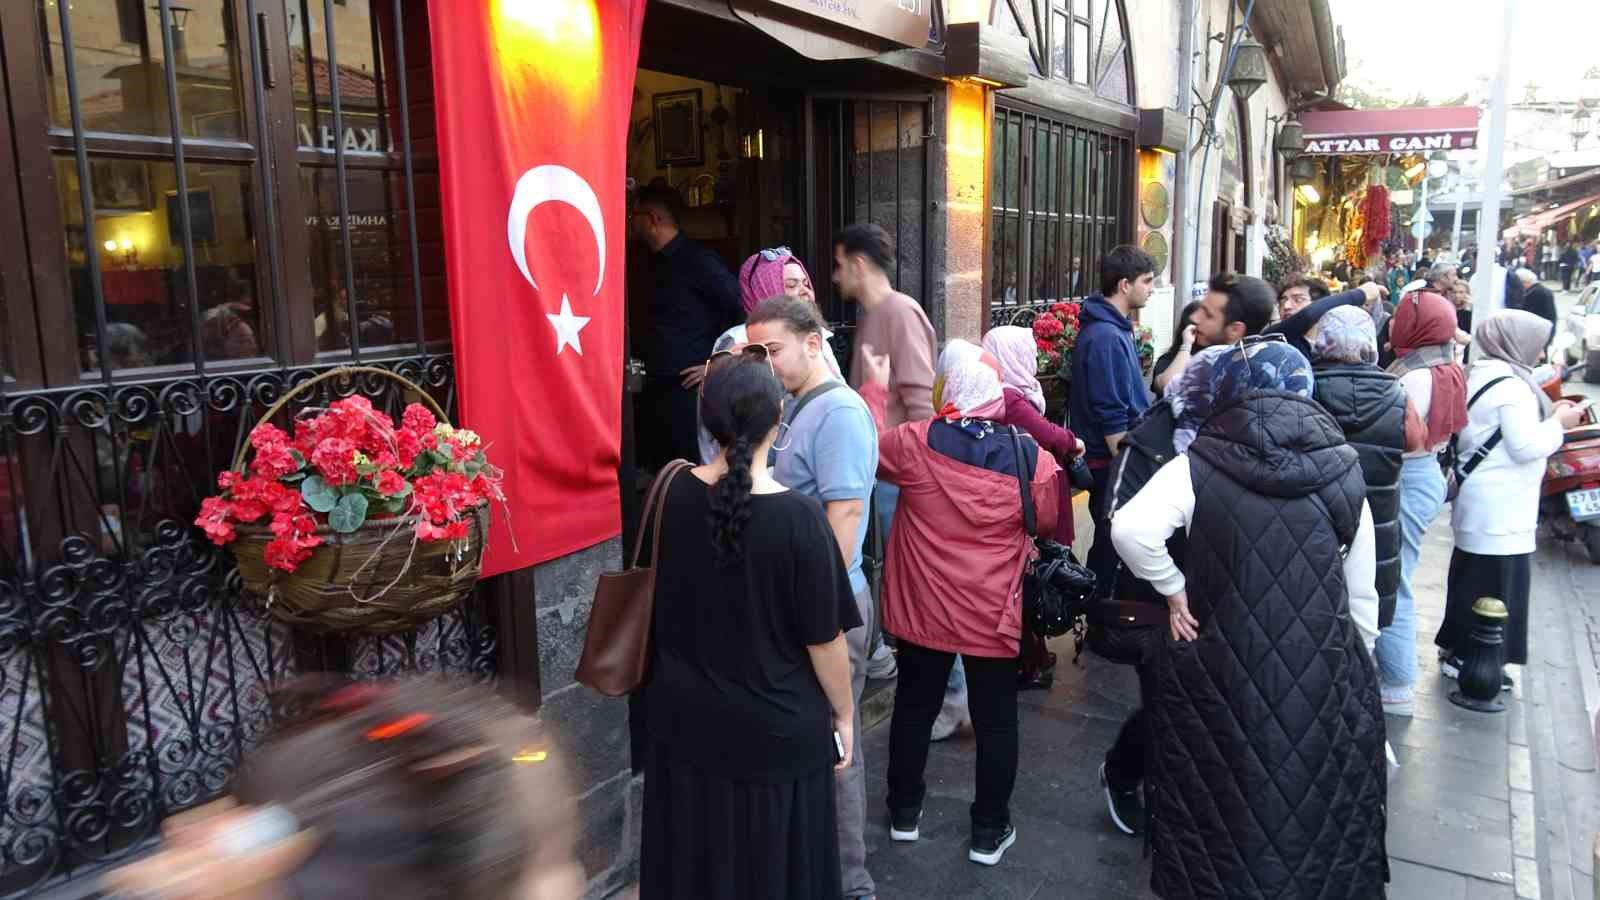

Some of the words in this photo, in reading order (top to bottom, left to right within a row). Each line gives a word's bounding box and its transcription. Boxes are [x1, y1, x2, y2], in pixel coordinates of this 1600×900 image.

[1304, 138, 1380, 153] ATTAR
[1389, 133, 1452, 150] GANİ
[1570, 493, 1585, 505] 27
